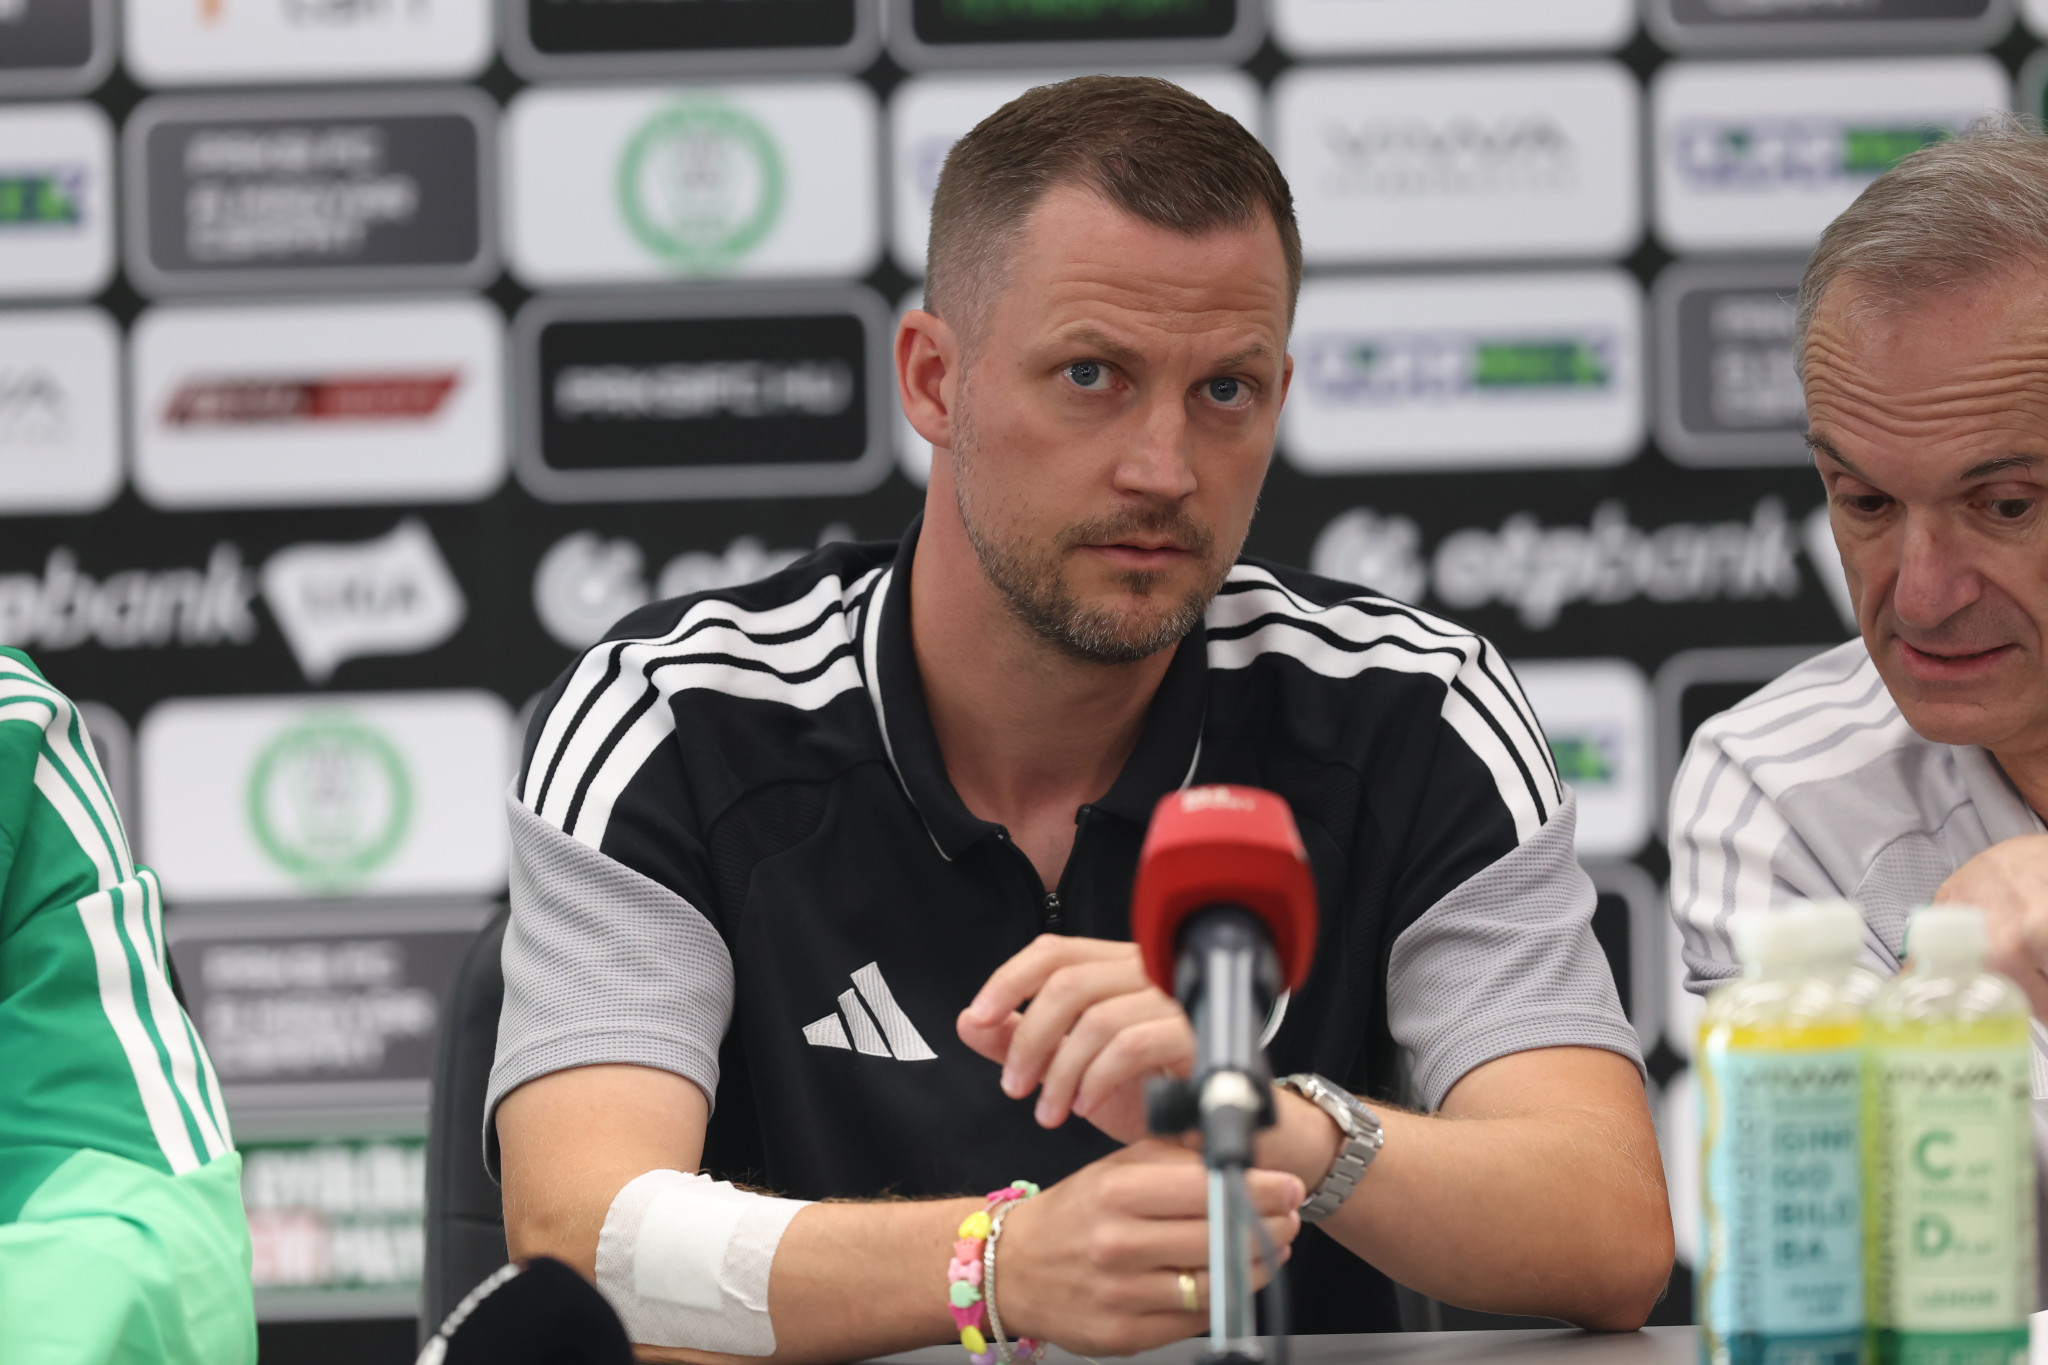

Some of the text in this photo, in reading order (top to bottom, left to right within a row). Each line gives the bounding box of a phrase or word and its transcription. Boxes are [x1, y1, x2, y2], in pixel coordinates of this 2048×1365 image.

[1432, 498, 1800, 630] otpbank
[1912, 1128, 1957, 1182] C
[1912, 1214, 1952, 1258] D
